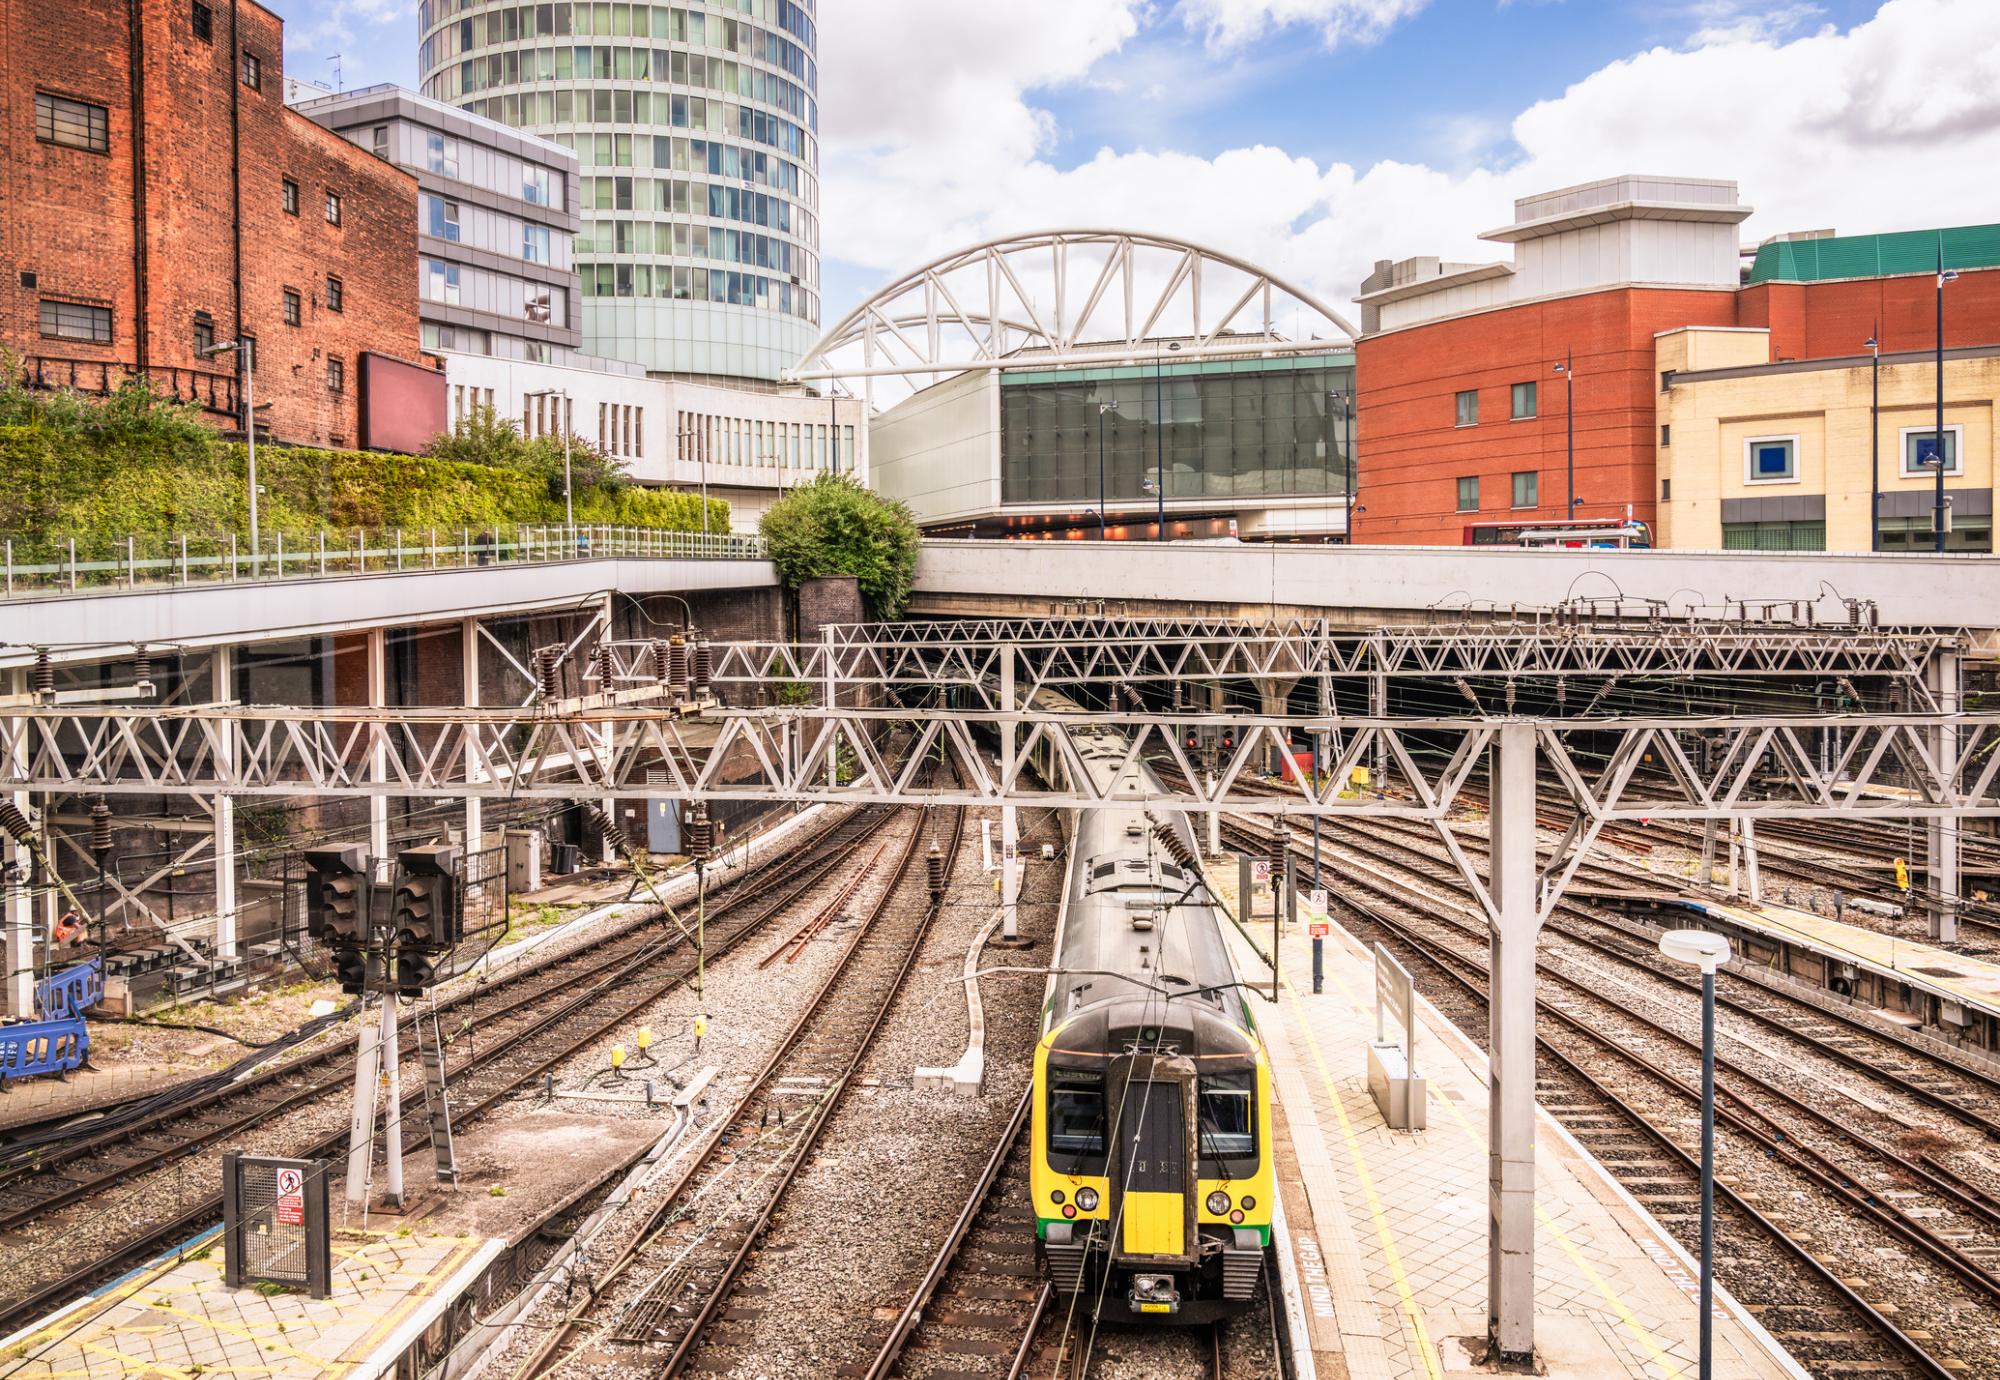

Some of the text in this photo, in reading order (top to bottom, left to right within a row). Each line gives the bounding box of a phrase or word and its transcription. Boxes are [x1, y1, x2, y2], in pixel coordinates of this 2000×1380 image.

[1298, 1236, 1334, 1317] MIND THE GAP
[1637, 1239, 1677, 1266] MIND
